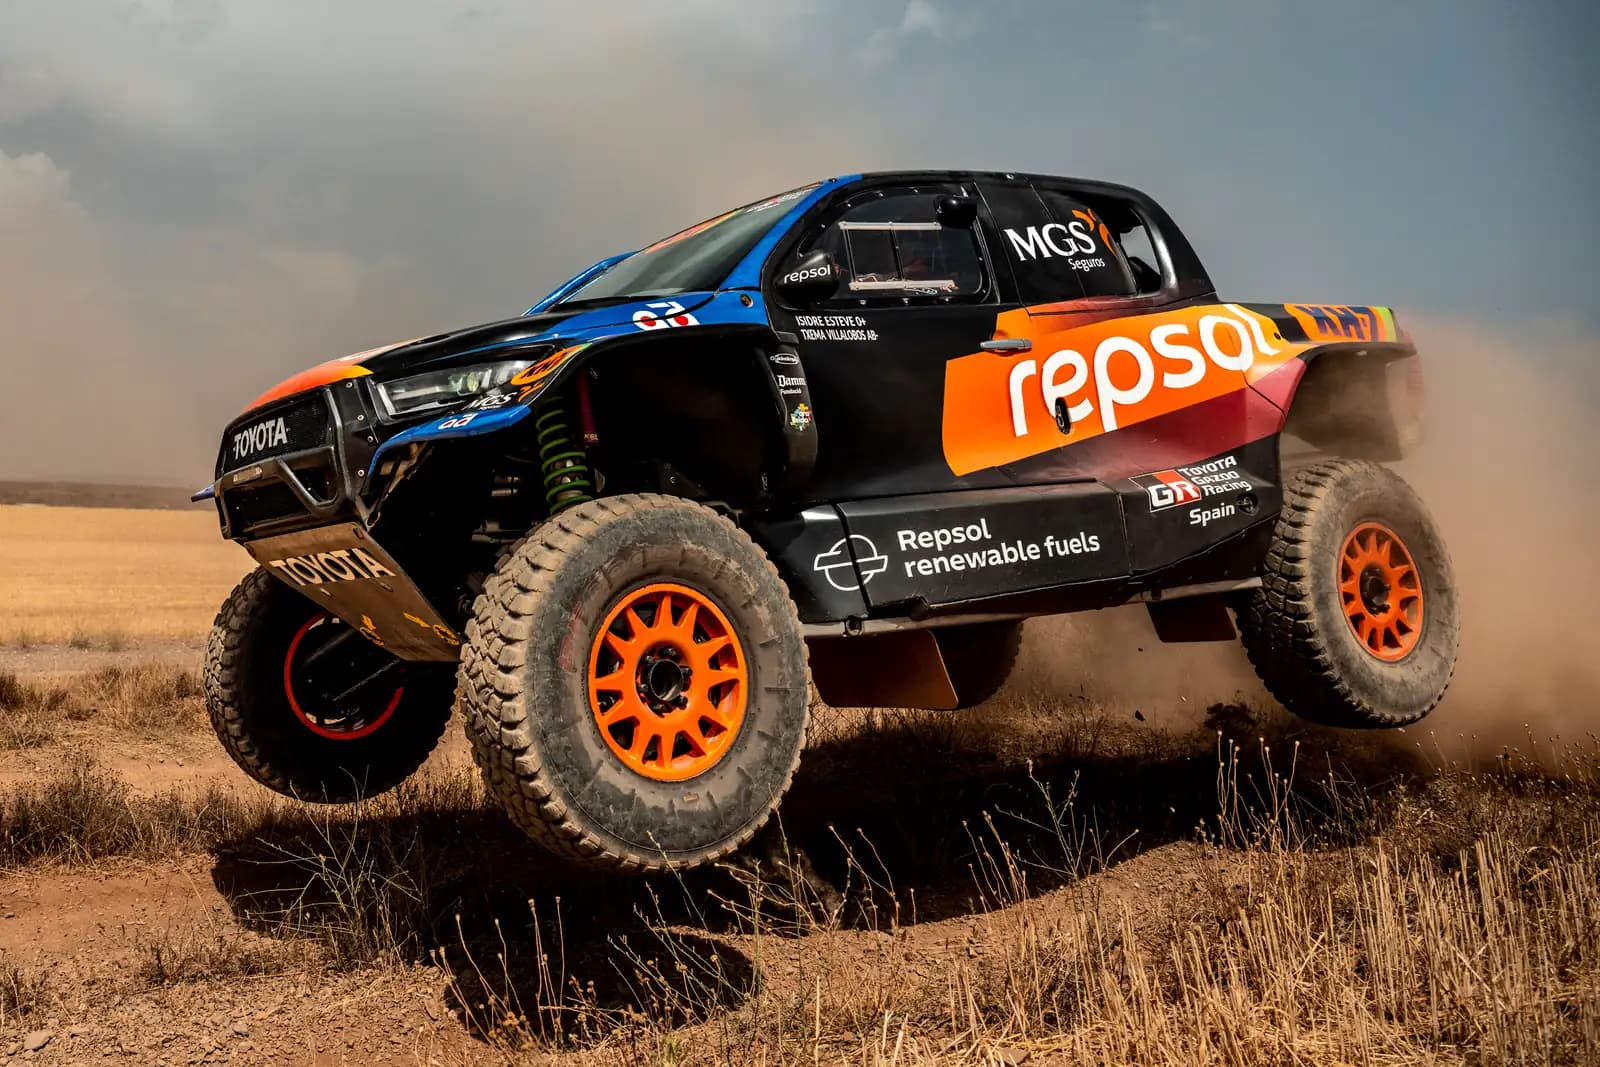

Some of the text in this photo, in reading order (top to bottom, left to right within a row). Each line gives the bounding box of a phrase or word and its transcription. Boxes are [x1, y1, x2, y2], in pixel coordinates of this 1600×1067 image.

[1003, 221, 1097, 261] MGS
[784, 264, 831, 284] repsol
[1068, 258, 1106, 272] Seguros
[795, 315, 825, 327] ISIDRE
[825, 315, 856, 327] ESTEVE
[801, 329, 826, 341] TXEMA
[827, 329, 867, 341] VILLALOBOS
[777, 374, 807, 387] Damm
[1009, 304, 1281, 438] repsol
[234, 417, 288, 460] TOYOTA
[1178, 455, 1238, 477] TOYOTA
[1148, 480, 1200, 508] GR
[1201, 480, 1253, 497] Racing
[1189, 502, 1236, 527] Spain
[896, 518, 992, 552] Repsol
[904, 531, 1101, 578] renewable fuels
[269, 548, 397, 587] TOYOTA
